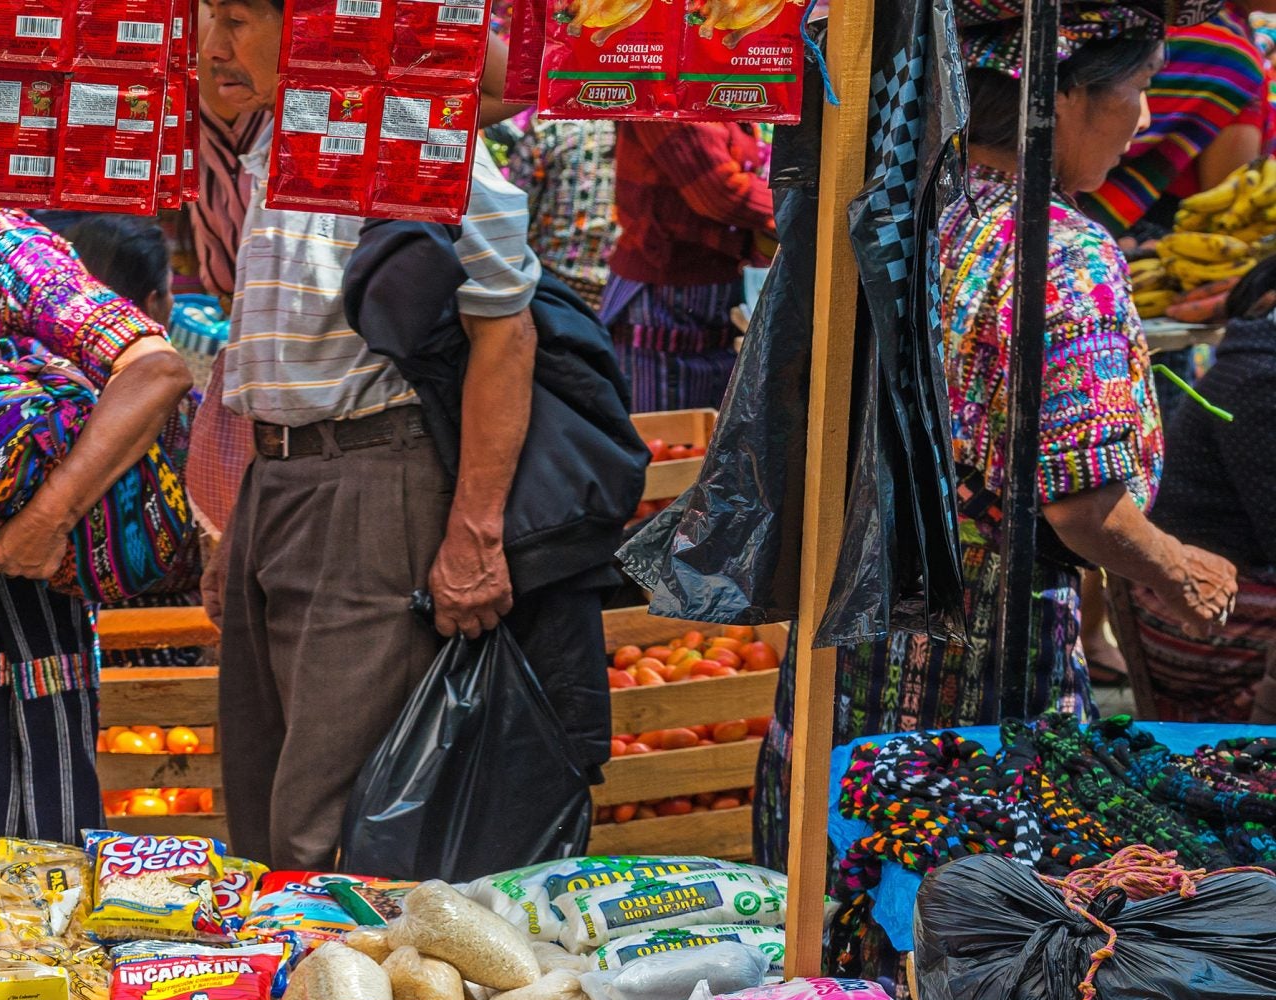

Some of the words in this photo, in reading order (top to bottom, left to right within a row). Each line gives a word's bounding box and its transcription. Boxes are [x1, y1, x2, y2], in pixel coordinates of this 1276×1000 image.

[616, 43, 649, 53] FIDEOS
[748, 46, 780, 56] FIDEOS
[599, 54, 629, 63] POLLO
[643, 54, 663, 63] SOPA
[731, 56, 760, 66] POLLO
[761, 57, 771, 65] DE
[773, 57, 792, 66] SOPA
[588, 87, 628, 99] MALHER
[719, 90, 758, 102] MALHER
[103, 837, 209, 857] CHAO
[101, 851, 208, 877] MEIN
[618, 886, 698, 911] HIERRO
[657, 895, 707, 914] azúcar
[623, 906, 652, 921] con
[120, 961, 254, 985] INCAPARINA
